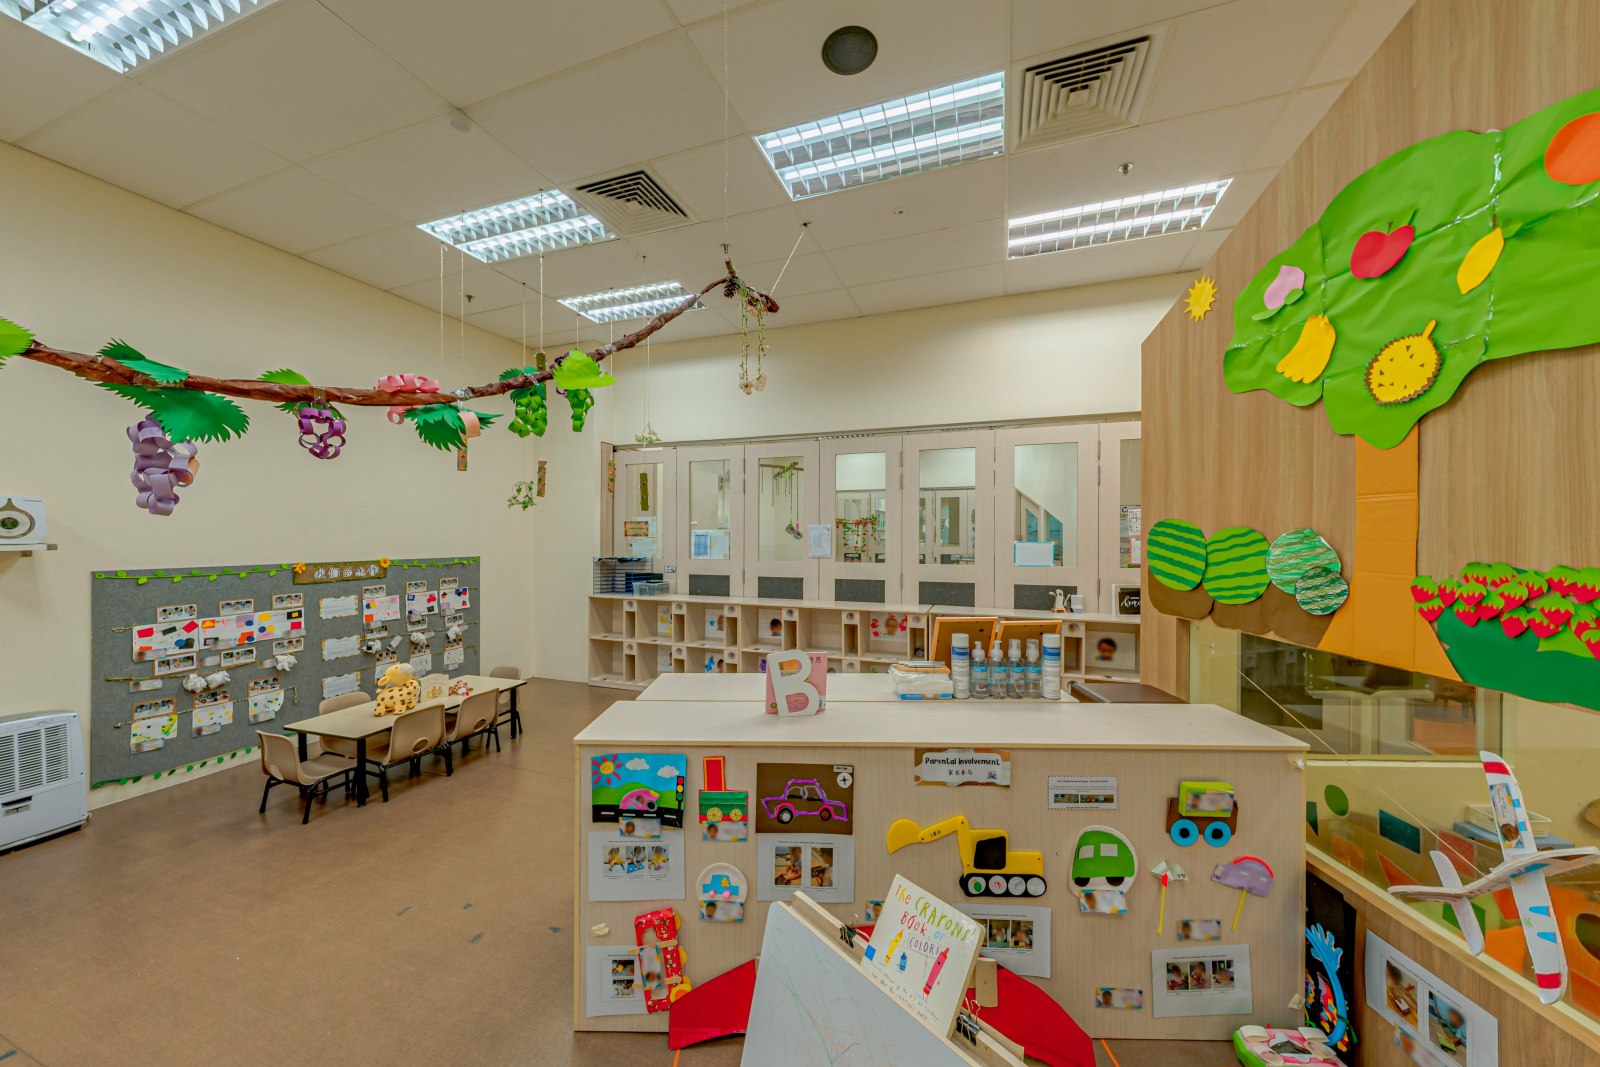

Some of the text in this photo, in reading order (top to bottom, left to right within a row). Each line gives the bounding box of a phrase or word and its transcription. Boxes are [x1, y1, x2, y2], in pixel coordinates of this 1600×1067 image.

[767, 649, 820, 718] B
[925, 757, 1000, 766] Parental Involvement
[894, 883, 912, 905] The
[909, 937, 940, 956] COLORS
